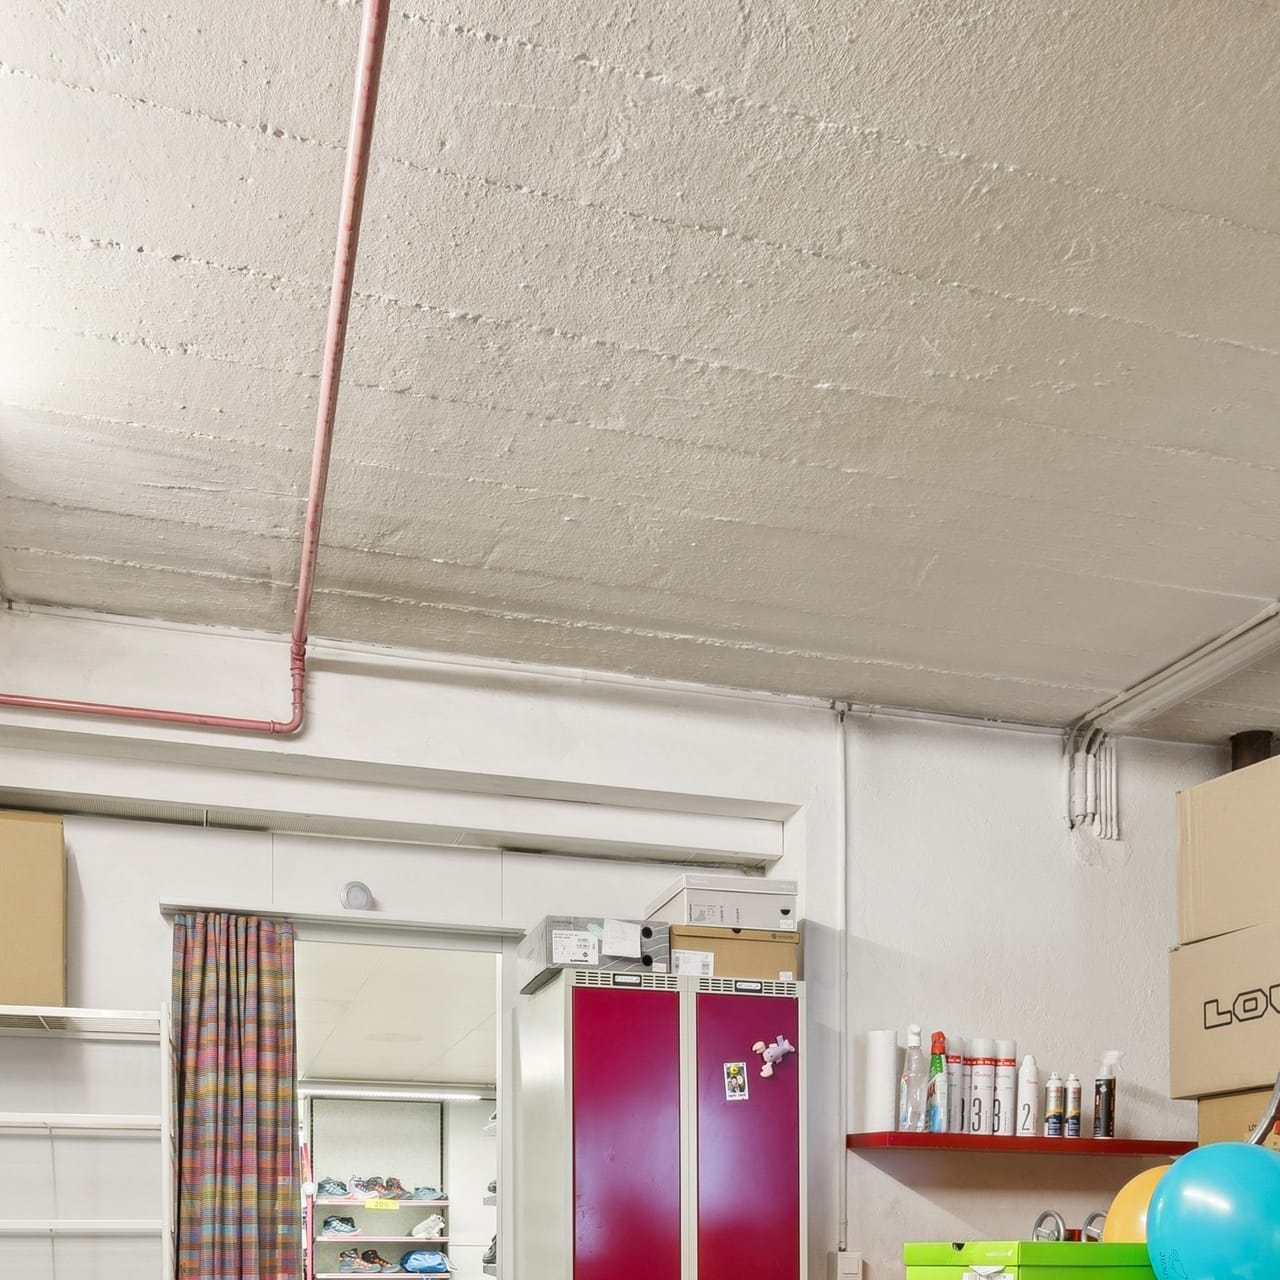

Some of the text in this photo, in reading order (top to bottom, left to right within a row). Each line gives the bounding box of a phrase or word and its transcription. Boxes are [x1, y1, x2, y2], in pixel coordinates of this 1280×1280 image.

[972, 1097, 982, 1132] 3
[993, 1098, 1001, 1133] 3
[1021, 1103, 1031, 1131] 2
